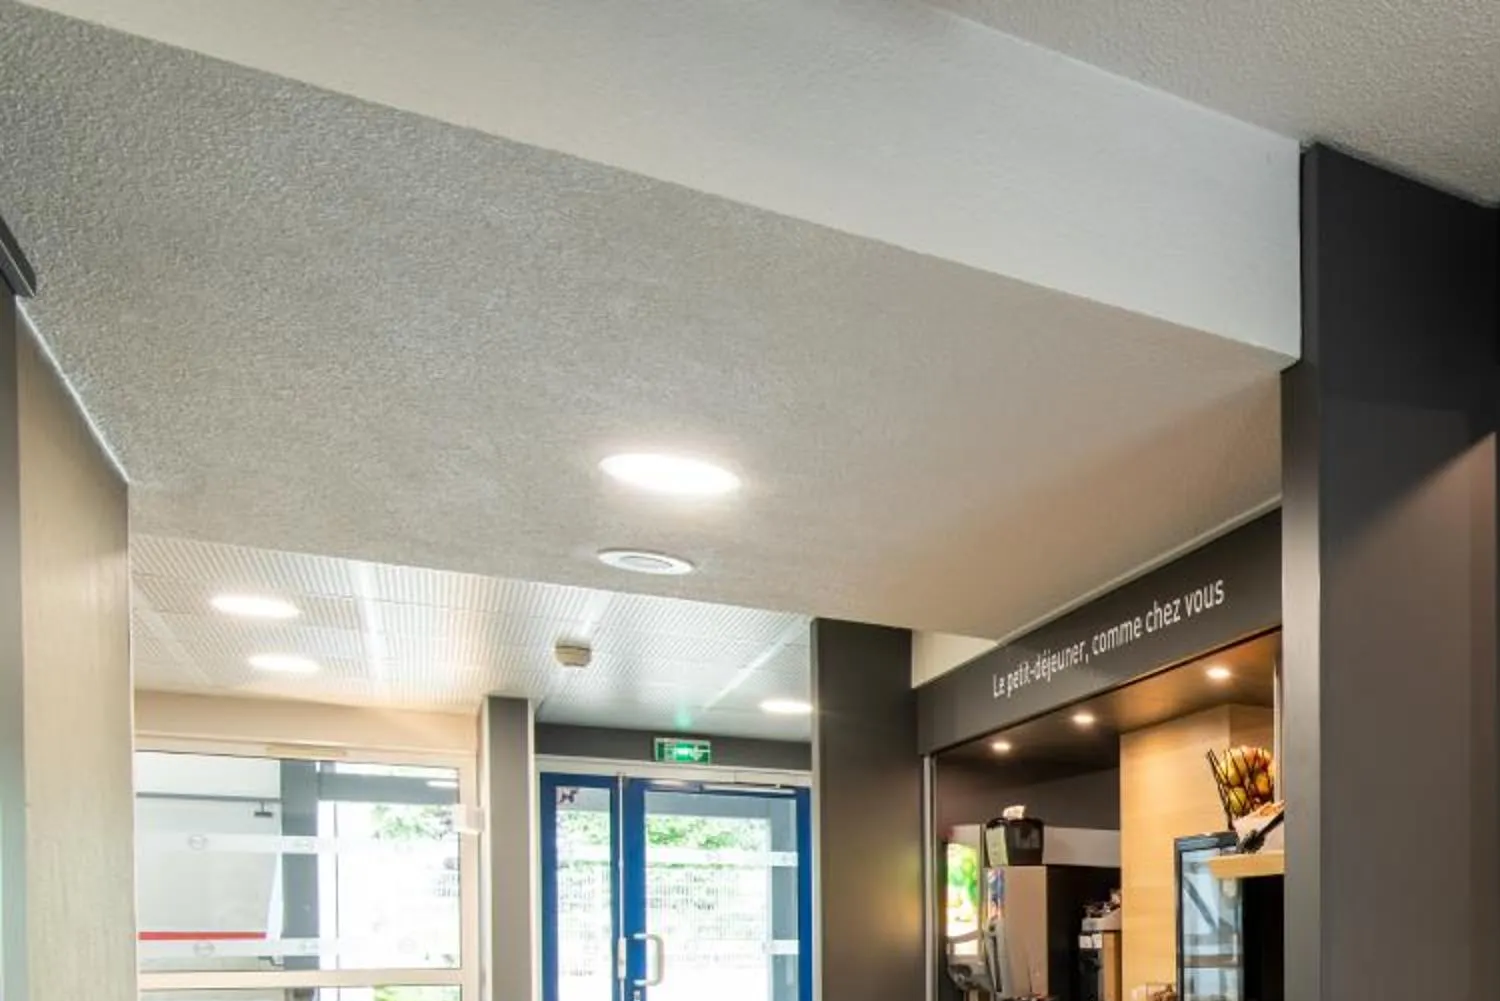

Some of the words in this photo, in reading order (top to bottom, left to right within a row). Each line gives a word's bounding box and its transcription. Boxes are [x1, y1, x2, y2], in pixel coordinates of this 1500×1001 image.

[993, 674, 1005, 699] Le
[1007, 641, 1090, 699] petit-déjeuner,
[1092, 616, 1142, 656] comme
[1145, 600, 1181, 633] chez
[1184, 579, 1225, 617] vous
